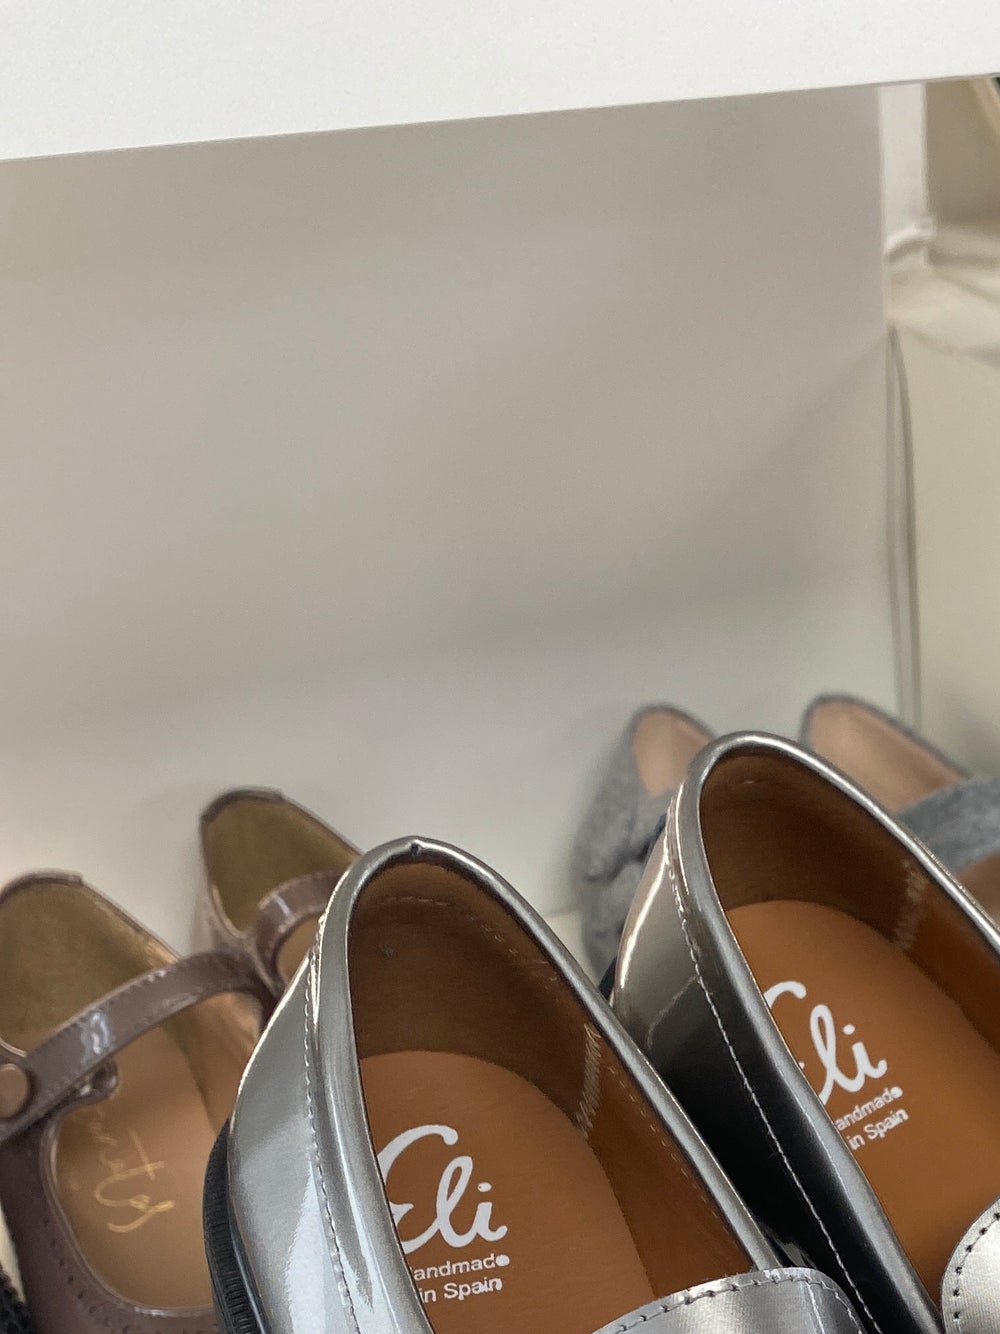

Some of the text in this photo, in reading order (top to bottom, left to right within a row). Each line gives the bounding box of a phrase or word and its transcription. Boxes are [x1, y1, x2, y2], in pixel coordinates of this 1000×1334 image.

[834, 1086, 903, 1131] andmad
[848, 1109, 909, 1150] in Spain
[377, 1124, 508, 1255] Eli
[410, 1253, 510, 1280] andmad
[420, 1276, 503, 1303] in Spain
